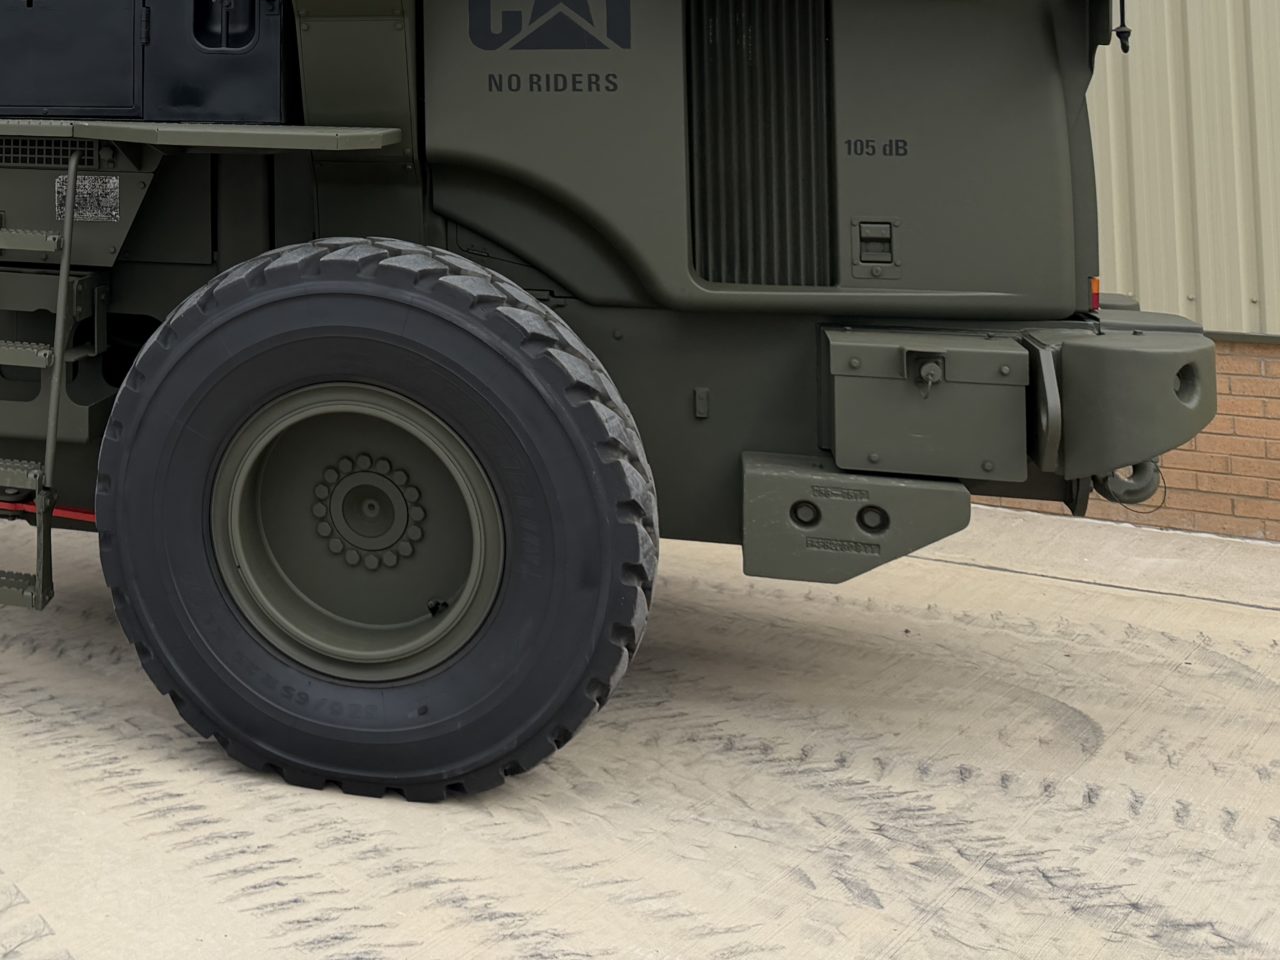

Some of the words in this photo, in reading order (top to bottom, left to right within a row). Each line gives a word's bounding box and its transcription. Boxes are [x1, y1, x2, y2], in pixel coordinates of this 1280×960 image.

[488, 73, 521, 92] NO
[529, 73, 619, 92] RIDERS
[844, 139, 876, 156] 105
[882, 139, 908, 156] dB
